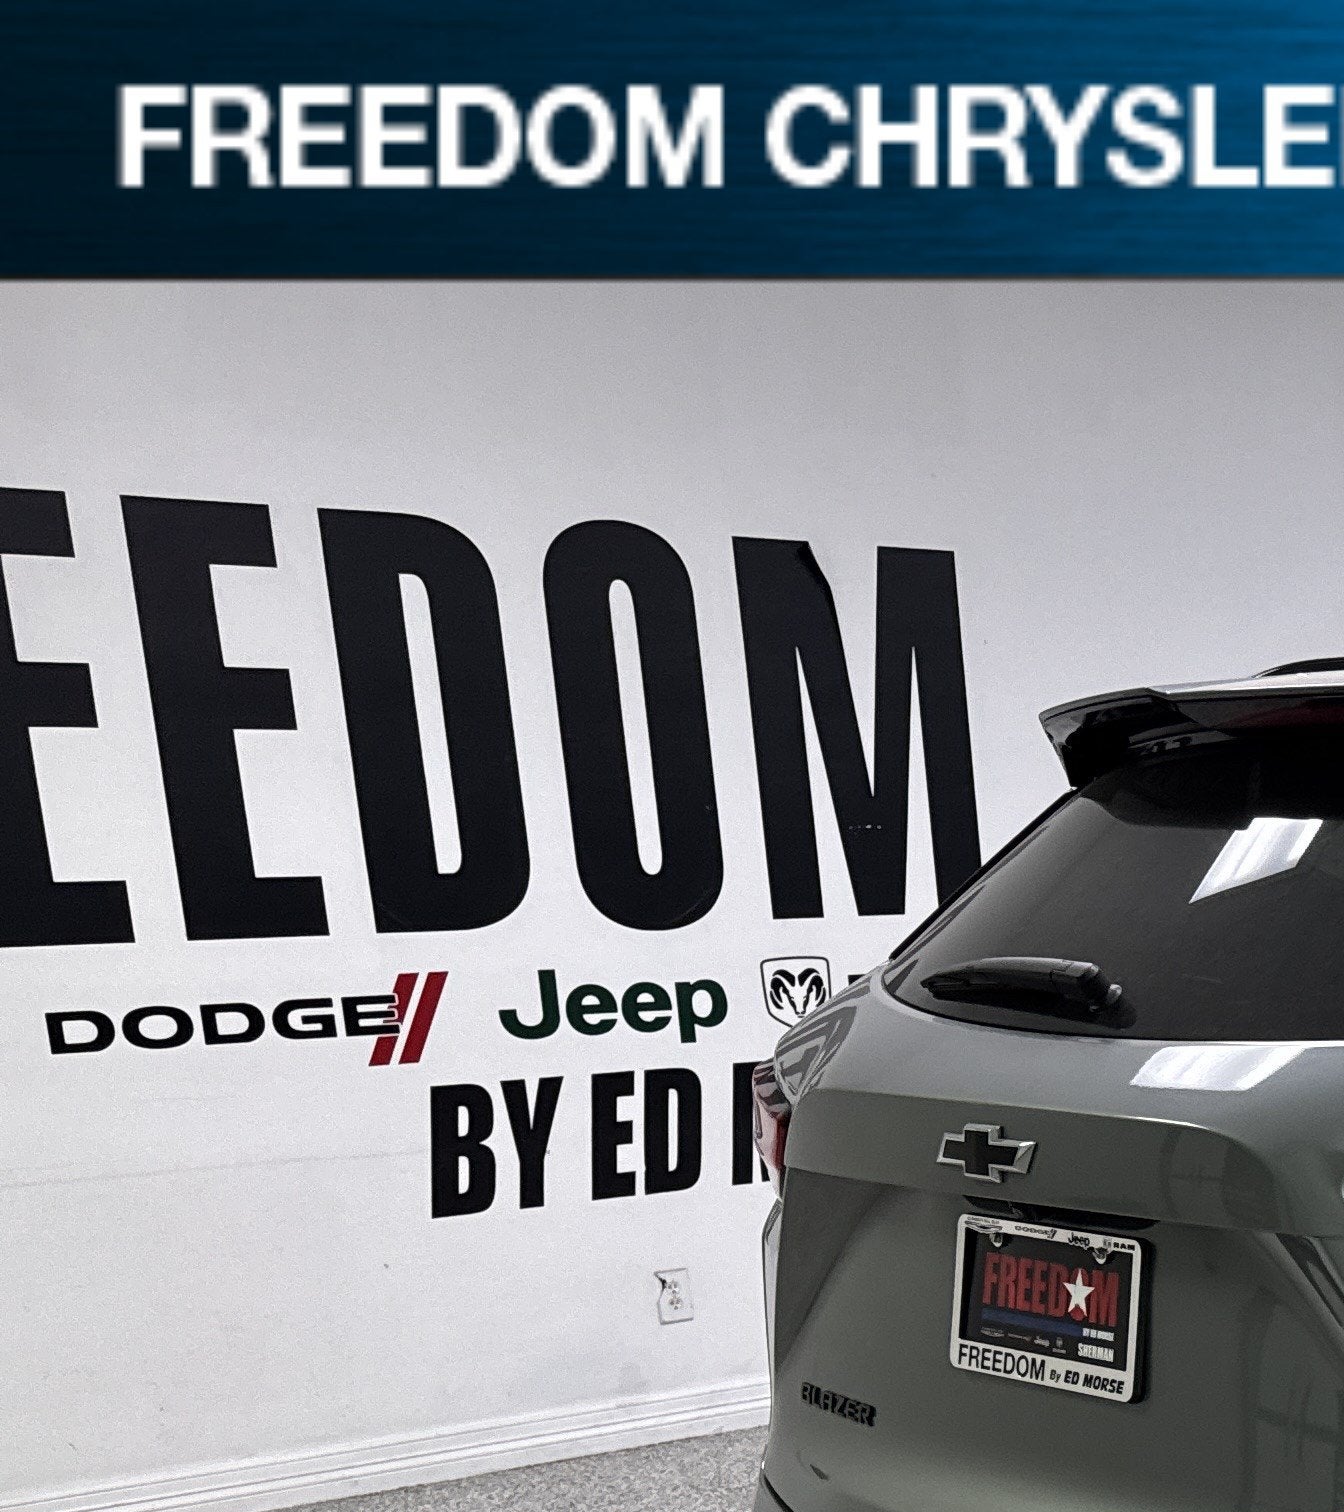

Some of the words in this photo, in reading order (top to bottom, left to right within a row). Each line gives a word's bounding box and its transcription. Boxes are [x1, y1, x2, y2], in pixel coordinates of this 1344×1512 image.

[45, 995, 402, 1055] DODGE
[498, 969, 728, 1044] Jeep
[430, 1076, 564, 1219] BY
[591, 1067, 702, 1201] ED
[1068, 1232, 1091, 1248] Jeep
[957, 1343, 1046, 1381] FREEDOM
[1050, 1369, 1062, 1383] By
[1064, 1369, 1080, 1385] ED
[1082, 1373, 1126, 1395] MORSE
[800, 1381, 877, 1428] BLAZER
